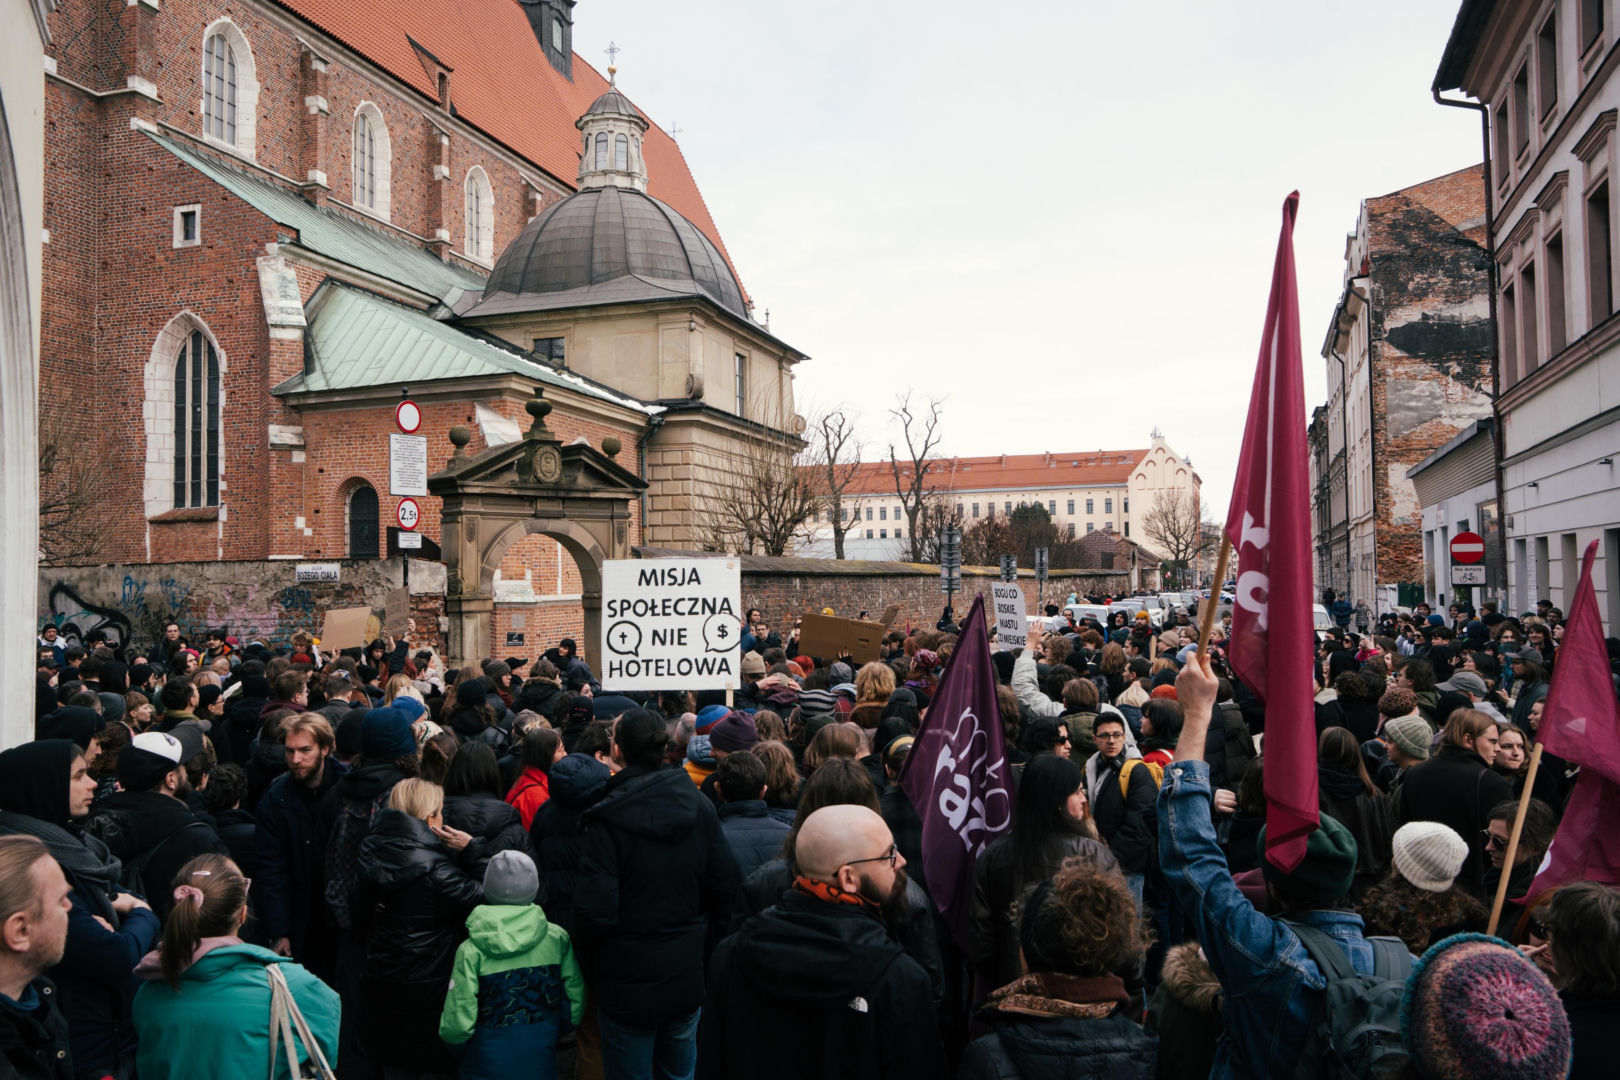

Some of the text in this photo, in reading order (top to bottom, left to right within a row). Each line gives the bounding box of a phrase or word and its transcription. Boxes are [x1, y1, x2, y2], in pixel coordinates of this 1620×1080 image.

[638, 567, 701, 586] MISJA
[995, 588, 1017, 599] BOGU CO
[607, 597, 734, 618] SPOŁECZNA
[998, 603, 1017, 615] BOSKIE,
[1000, 619, 1018, 630] MIASTU
[651, 628, 688, 646] NIE
[1004, 635, 1026, 646] MIEJSKIE
[608, 657, 732, 678] HOTELOWA
